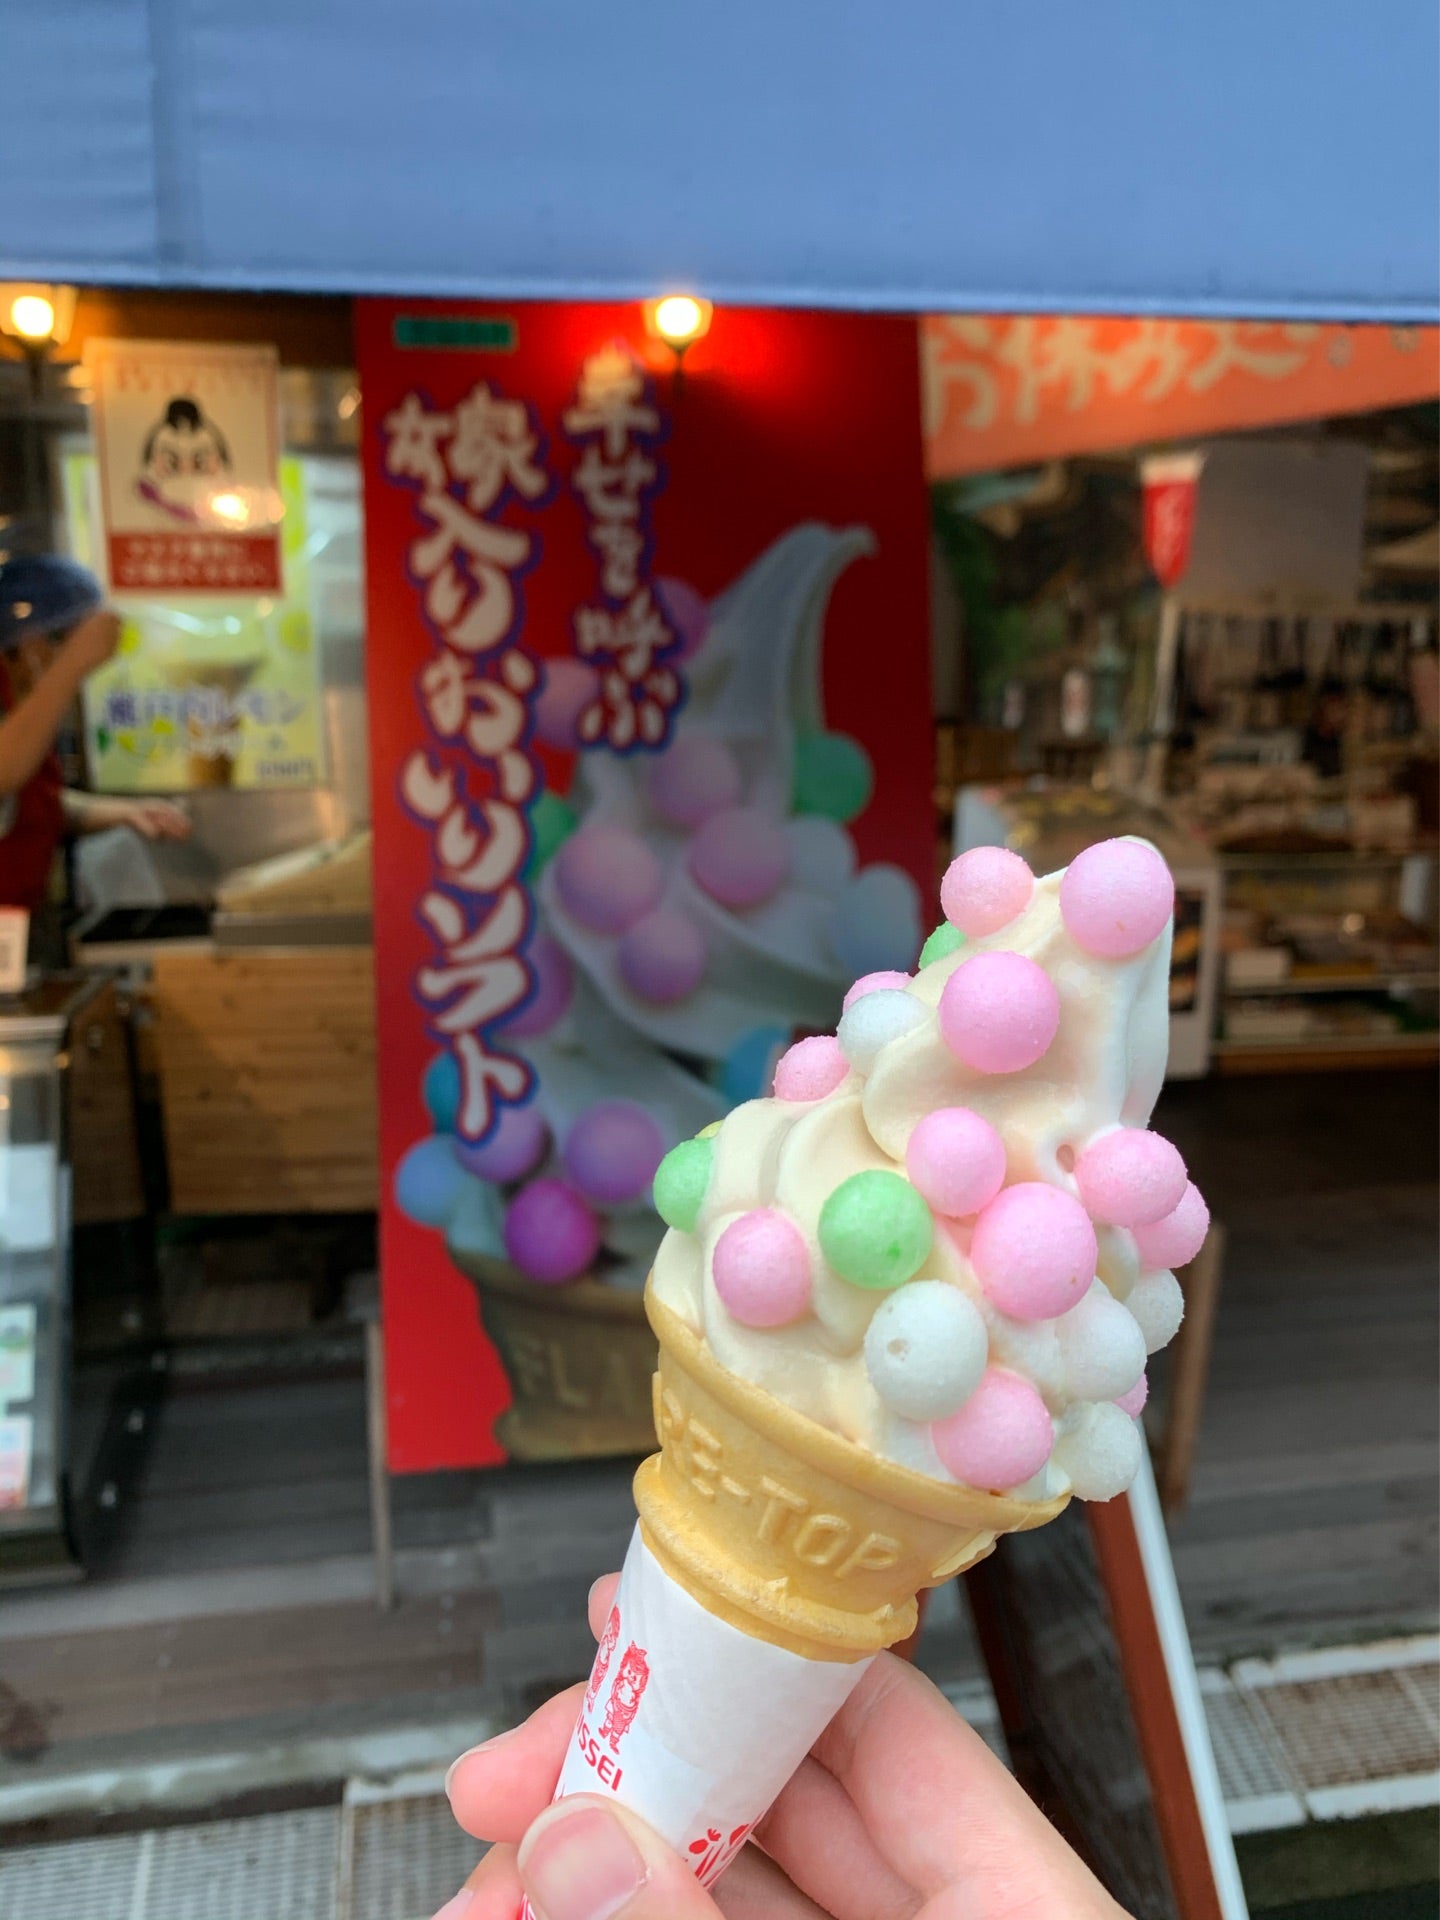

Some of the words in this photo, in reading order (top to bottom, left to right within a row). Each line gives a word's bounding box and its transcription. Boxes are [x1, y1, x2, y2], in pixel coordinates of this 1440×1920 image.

[384, 384, 547, 1139] 嫁入りおいりソフト
[563, 344, 677, 745] 幸せを呼ぶ
